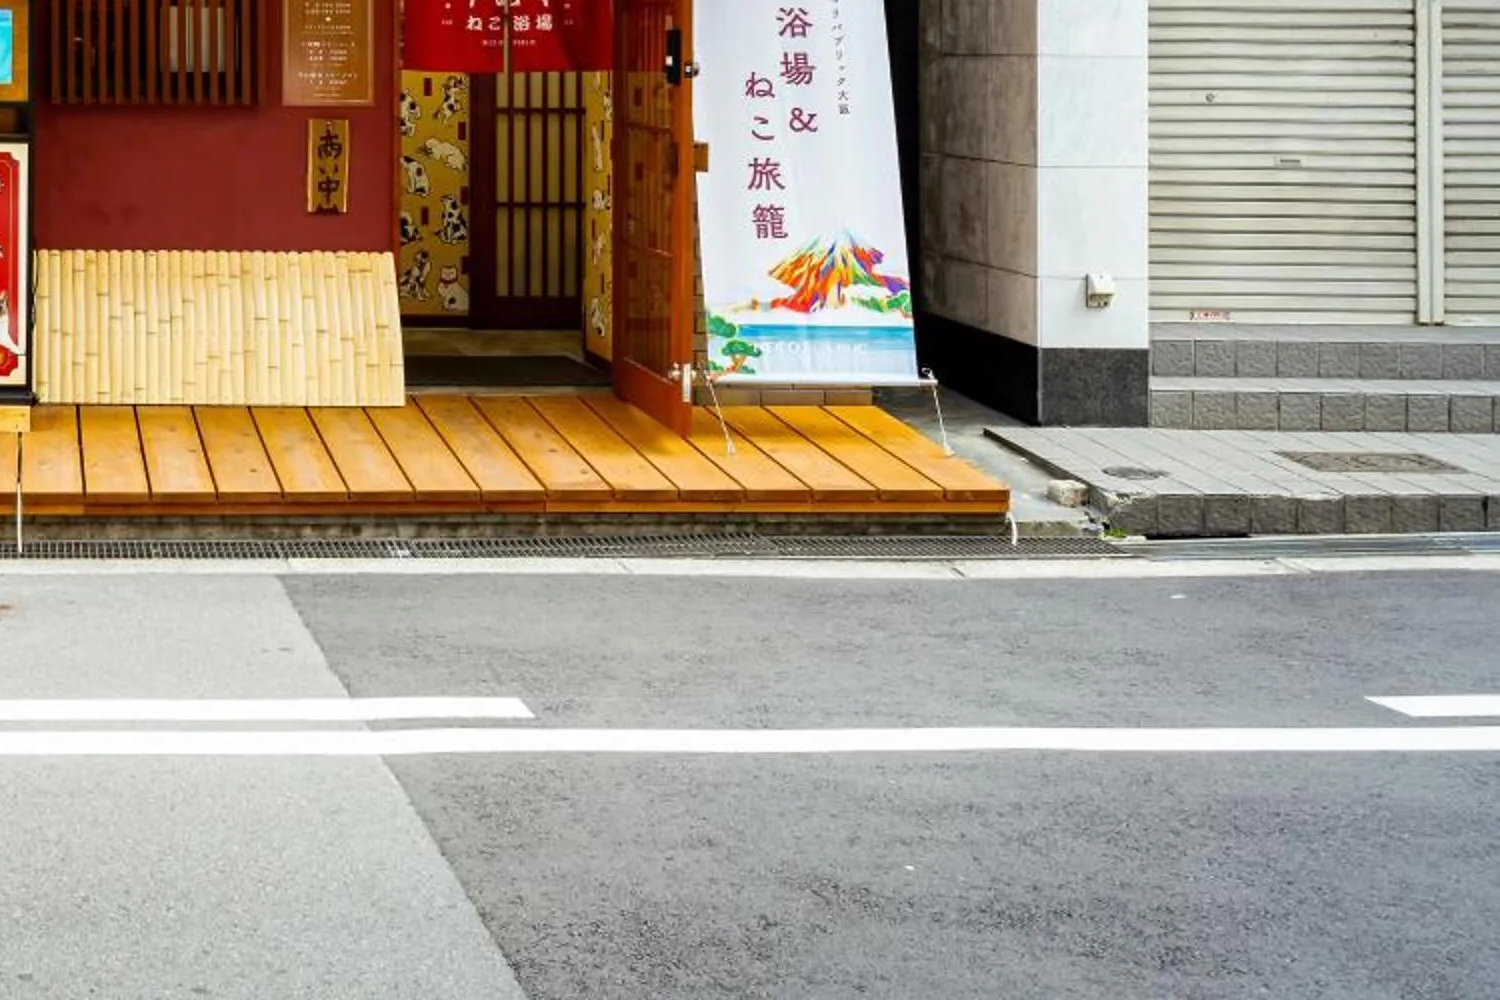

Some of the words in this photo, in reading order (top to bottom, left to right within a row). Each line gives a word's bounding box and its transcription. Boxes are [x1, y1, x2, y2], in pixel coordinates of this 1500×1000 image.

[466, 13, 553, 31] ねこ浴場
[745, 72, 789, 240] ねこ旅籠
